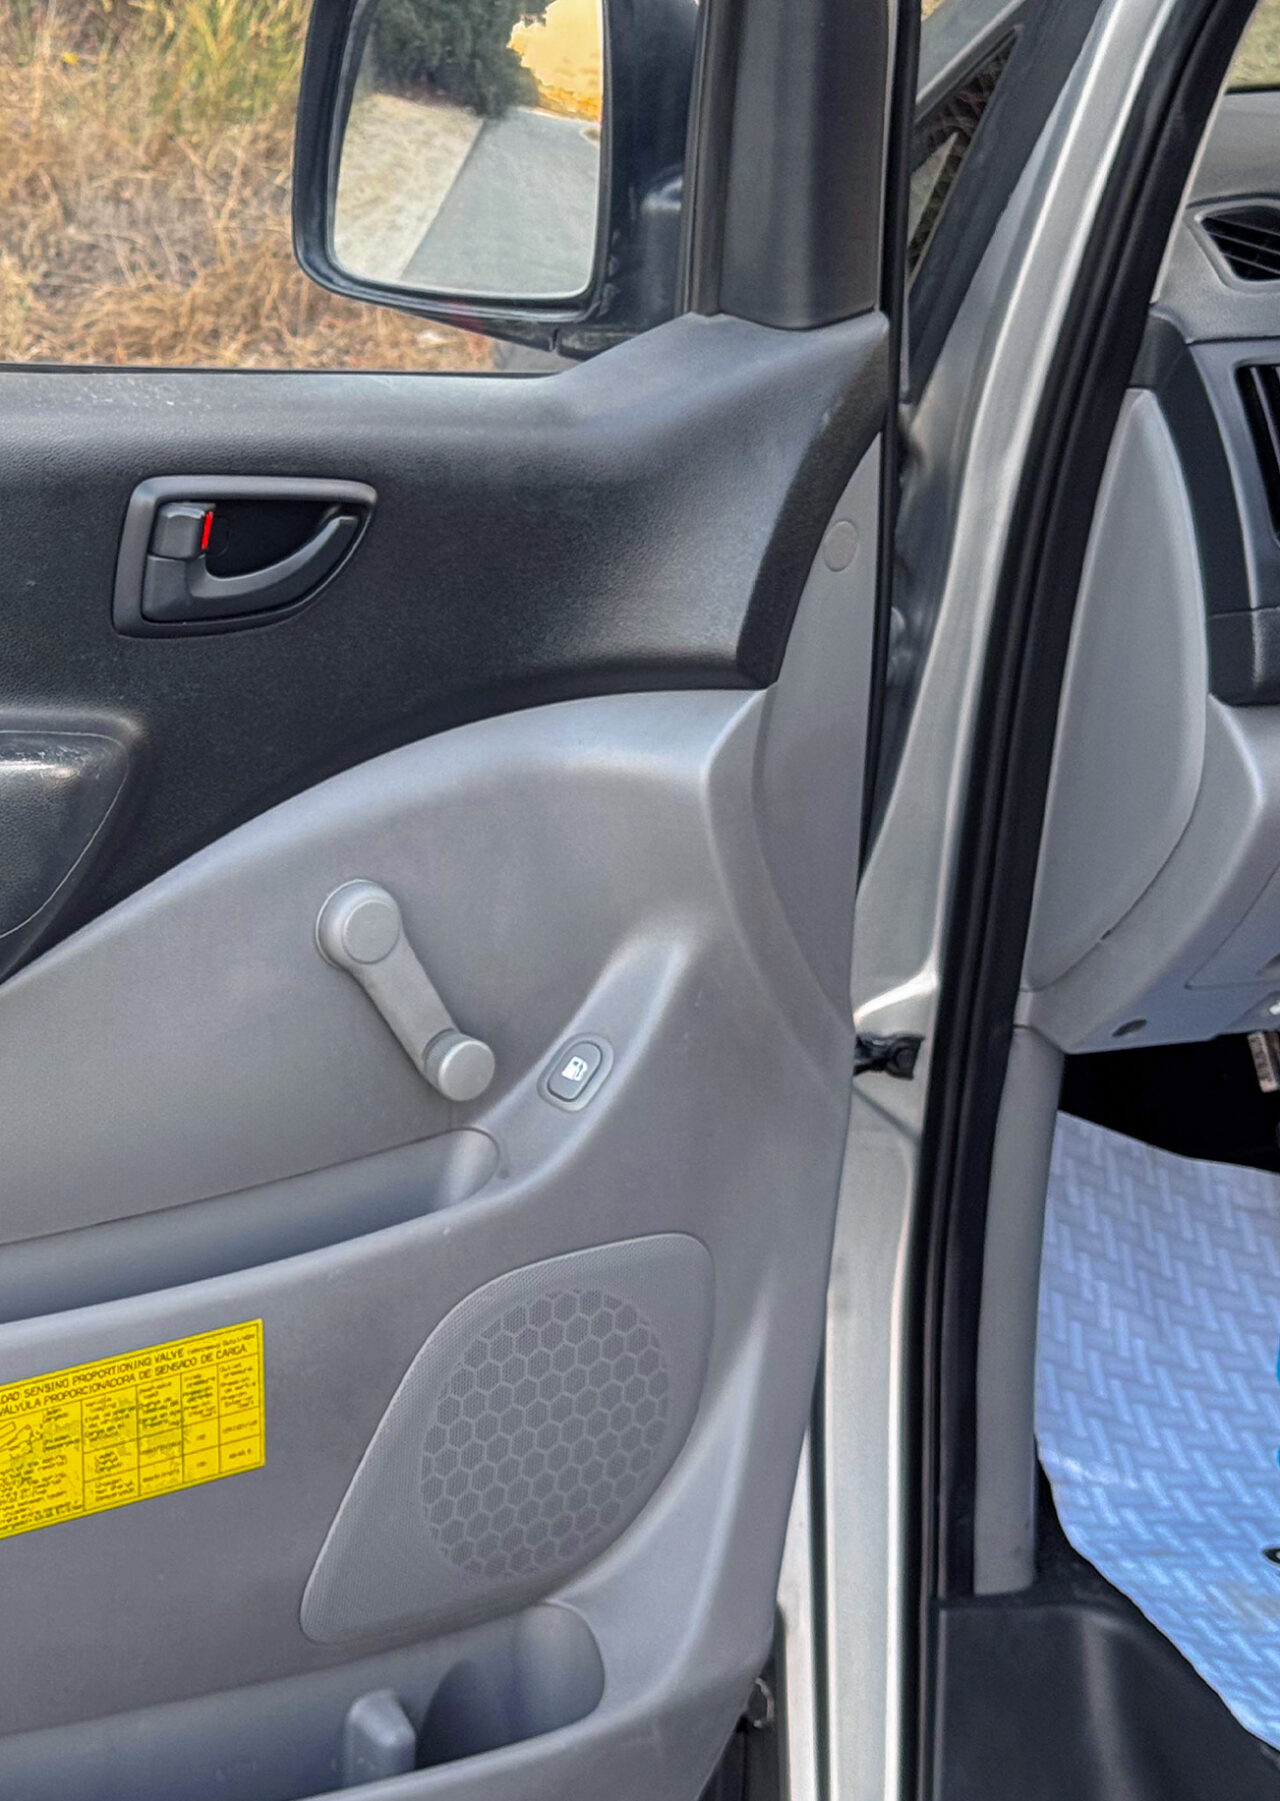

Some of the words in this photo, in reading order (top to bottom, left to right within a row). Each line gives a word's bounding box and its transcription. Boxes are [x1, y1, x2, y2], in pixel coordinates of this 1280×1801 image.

[24, 1377, 68, 1398] SENSING
[72, 1356, 151, 1385] PROPORTIONING
[154, 1347, 184, 1364] VALVE
[139, 1367, 152, 1380] DE
[200, 1351, 213, 1363] DE
